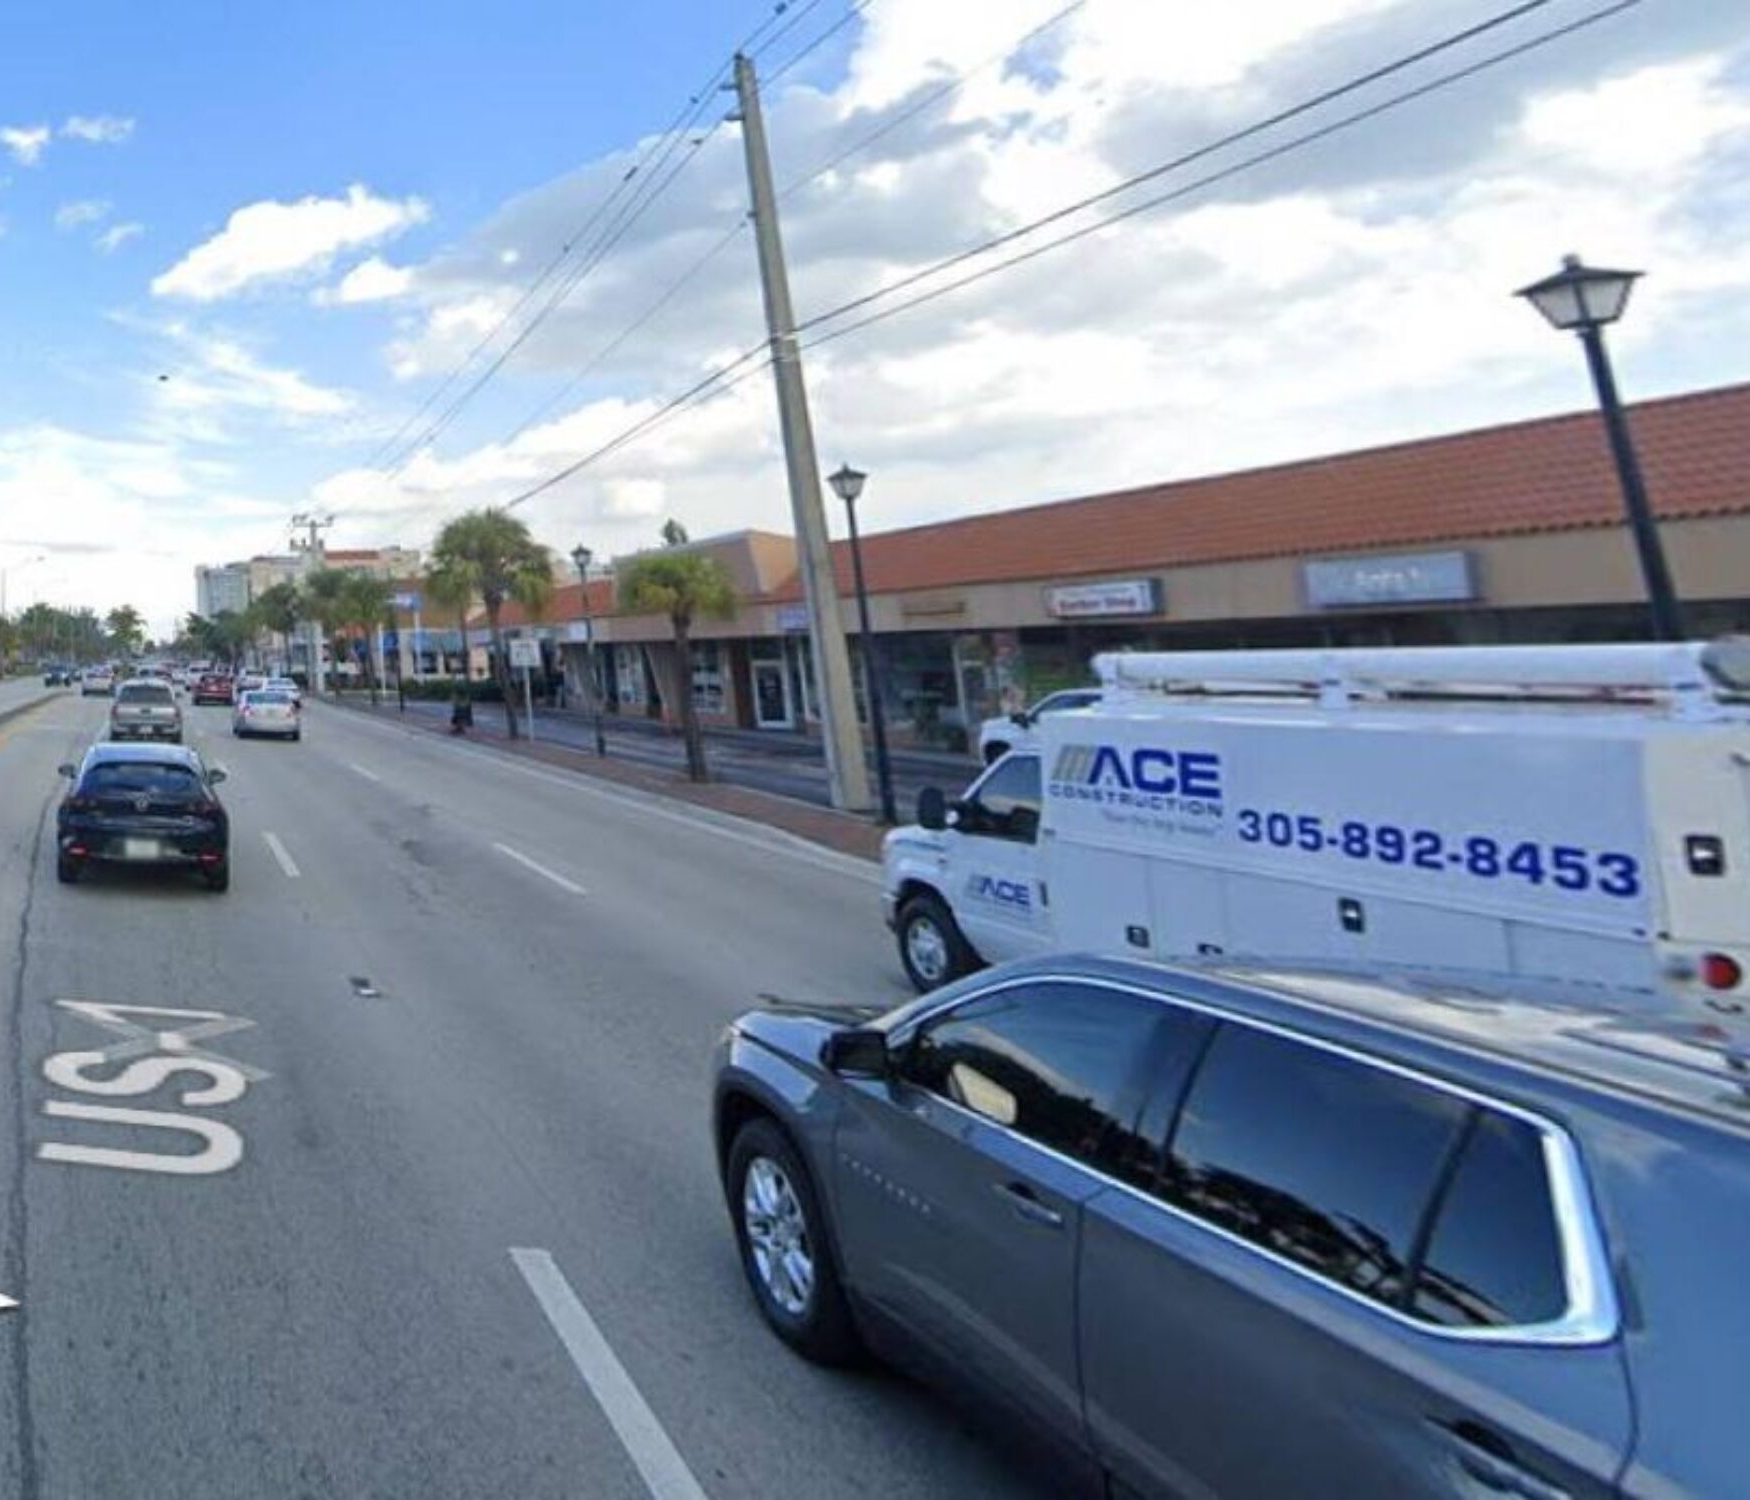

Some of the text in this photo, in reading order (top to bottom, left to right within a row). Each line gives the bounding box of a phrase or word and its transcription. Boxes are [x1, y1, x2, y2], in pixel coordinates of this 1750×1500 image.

[1087, 745, 1223, 799] ACE
[1049, 783, 1223, 819] CONSTRUCTION
[1237, 808, 1641, 898] 305-892-8453
[979, 877, 1031, 907] ACE
